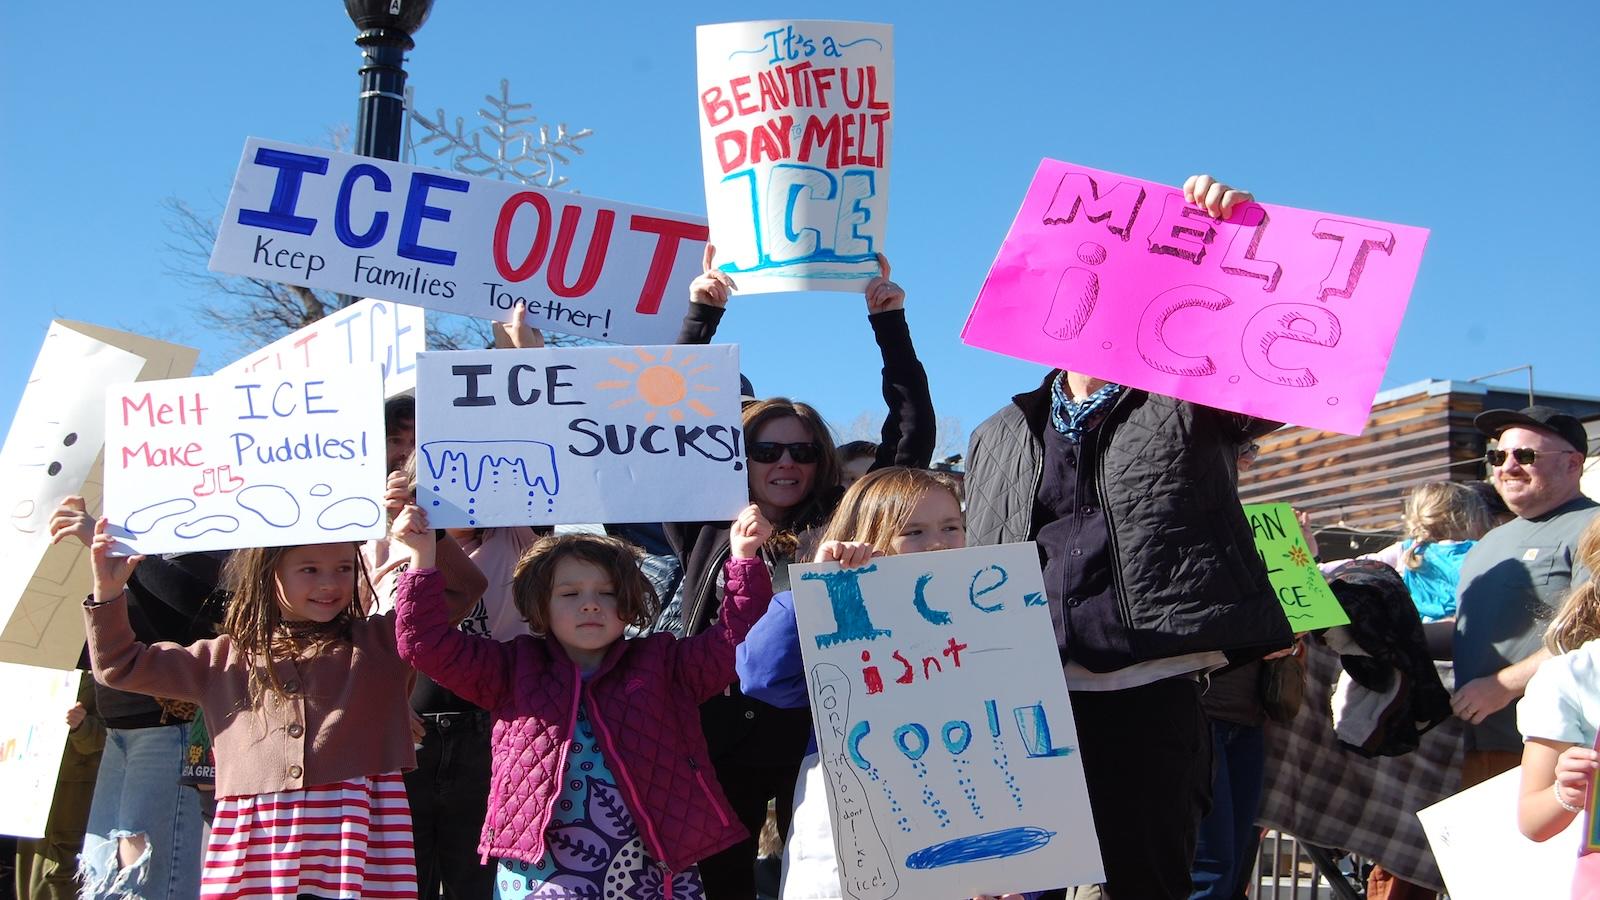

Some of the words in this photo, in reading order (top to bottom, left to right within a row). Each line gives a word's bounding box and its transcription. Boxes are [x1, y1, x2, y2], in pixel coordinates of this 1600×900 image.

[764, 25, 813, 64] It's
[823, 36, 842, 58] a
[701, 61, 890, 127] BEAUTIFUL
[715, 114, 793, 173] DAY
[797, 111, 890, 169] MELT
[237, 147, 470, 266] ICE
[493, 191, 709, 315] OUT
[718, 163, 879, 272] ICE
[1043, 173, 1396, 302] MELT
[253, 235, 325, 280] Keep
[354, 255, 458, 299] Families
[122, 393, 209, 427] Melt
[234, 380, 339, 420] ICE
[451, 364, 587, 407] ICE
[122, 441, 204, 469] Make
[230, 431, 368, 467] Puddles!
[568, 418, 744, 472] SUCKS!
